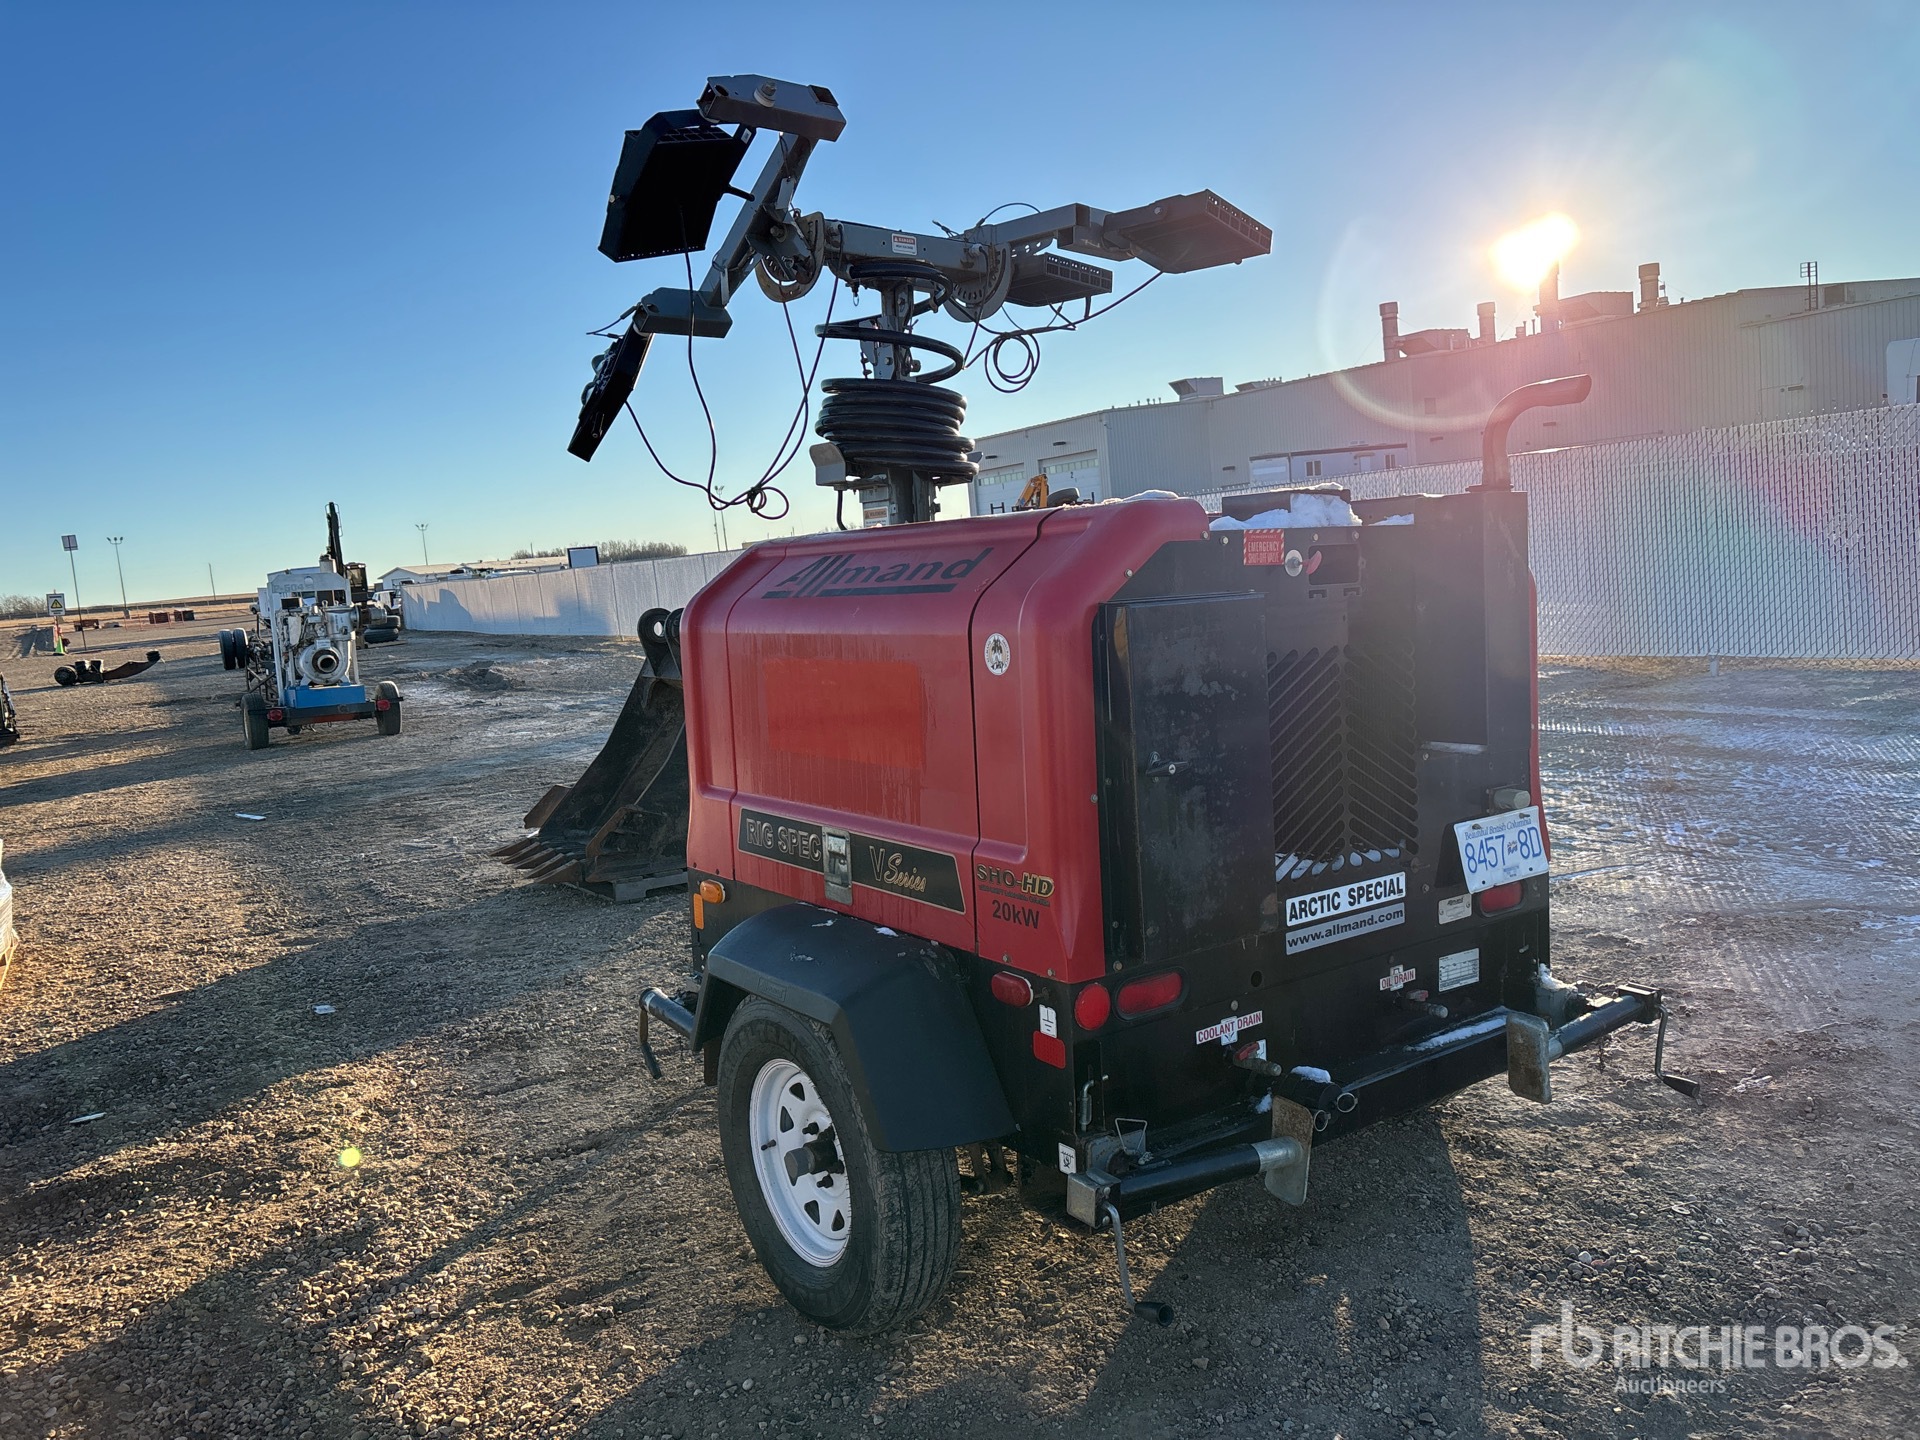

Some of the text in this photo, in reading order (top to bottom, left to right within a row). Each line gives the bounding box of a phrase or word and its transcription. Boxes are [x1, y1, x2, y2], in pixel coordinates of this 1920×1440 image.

[1248, 541, 1279, 552] EMERGENCY
[775, 547, 995, 598] Allmand
[746, 817, 822, 862] RIG SPEC
[1464, 818, 1532, 841] Beautiful British Columbia
[1464, 826, 1542, 874] 8457 8D
[869, 845, 927, 893] V Series
[976, 863, 1055, 898] SHO-HD
[991, 899, 1040, 930] 20kW
[1288, 876, 1404, 922] ARCTIC SPECIAL
[1287, 909, 1404, 948] www.allmand.com
[1381, 969, 1415, 989] OIL DRAIN
[1197, 1011, 1261, 1043] COOLANT DRAIN
